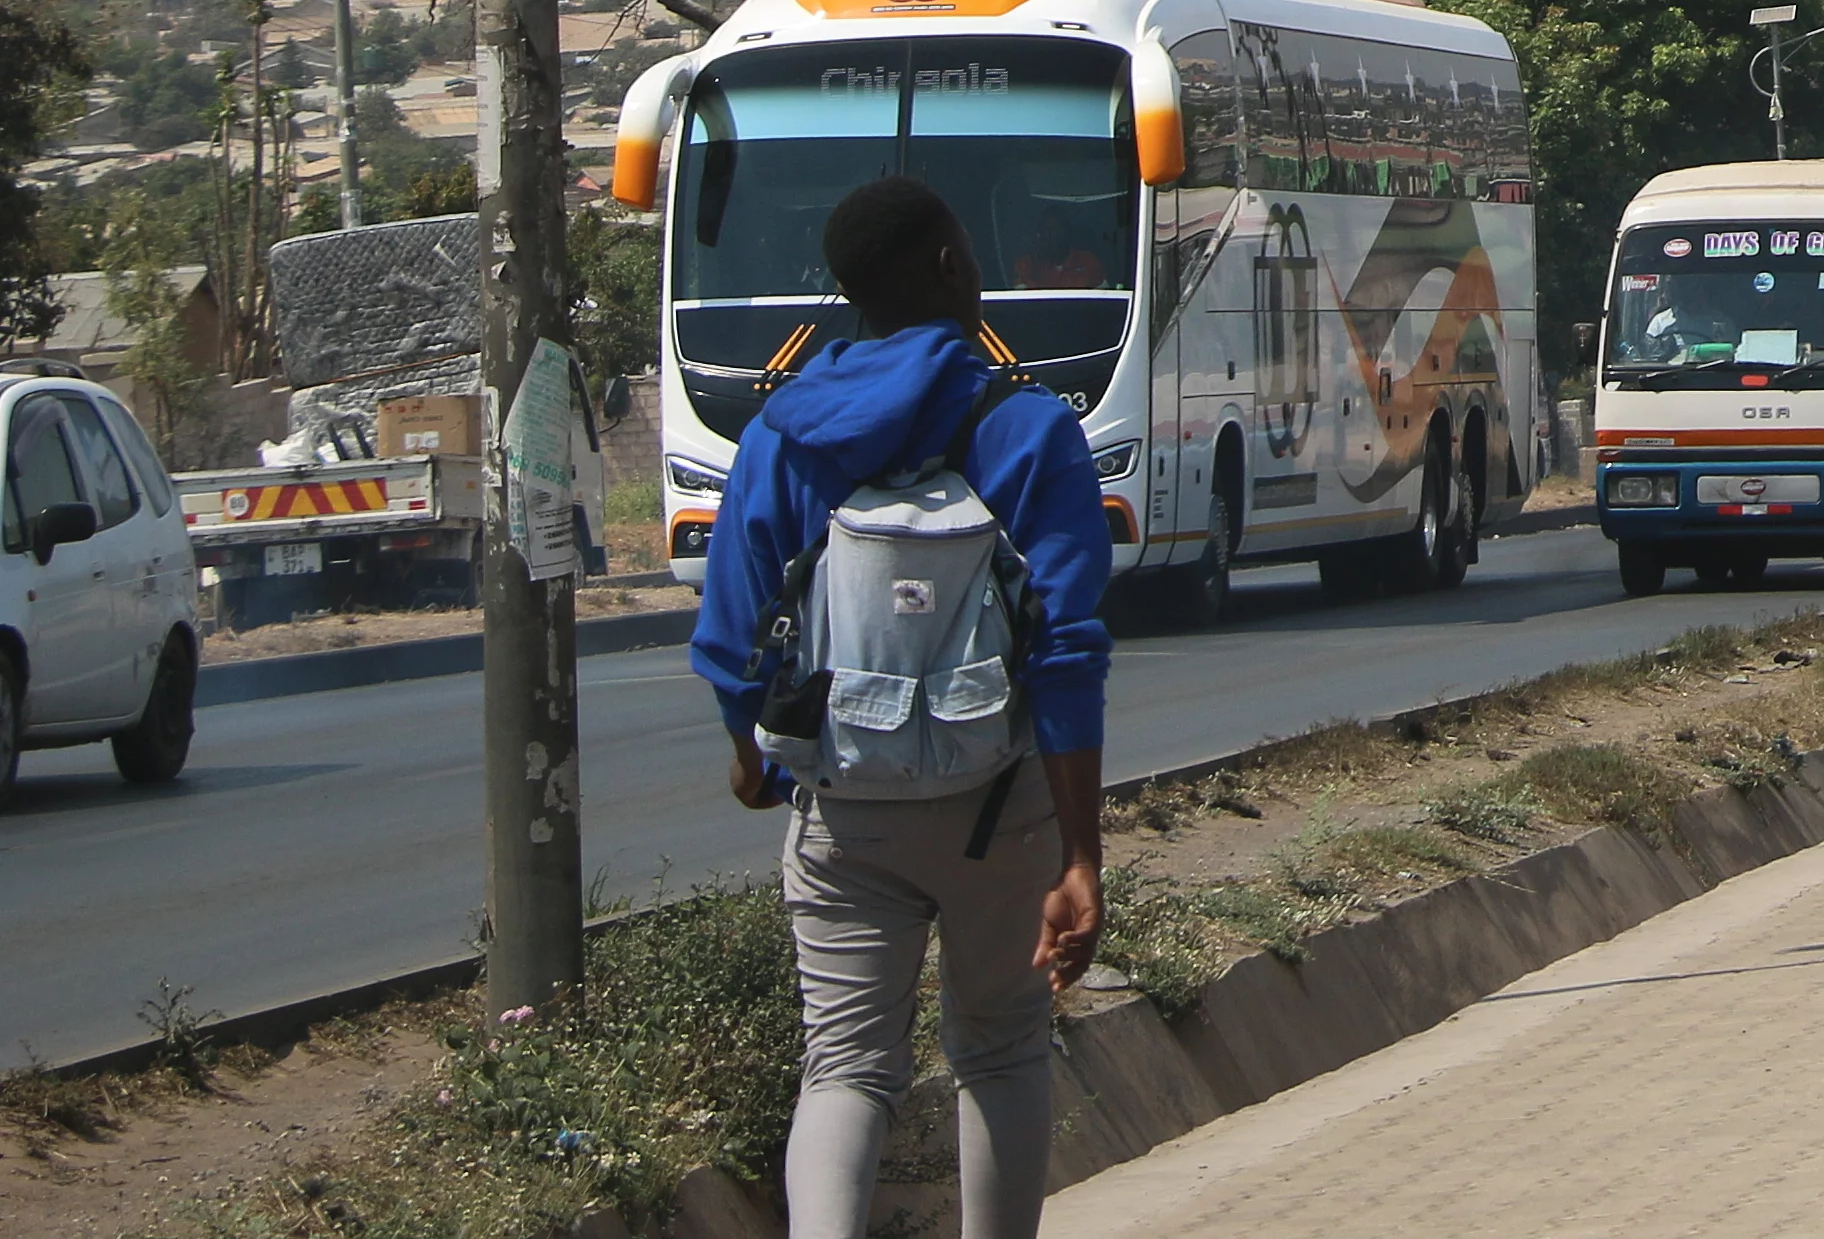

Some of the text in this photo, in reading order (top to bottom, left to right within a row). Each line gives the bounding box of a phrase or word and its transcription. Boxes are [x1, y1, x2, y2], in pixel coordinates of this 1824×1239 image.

[1704, 231, 1760, 257] DAYS
[1770, 231, 1799, 256] OF
[1742, 406, 1790, 419] OSA
